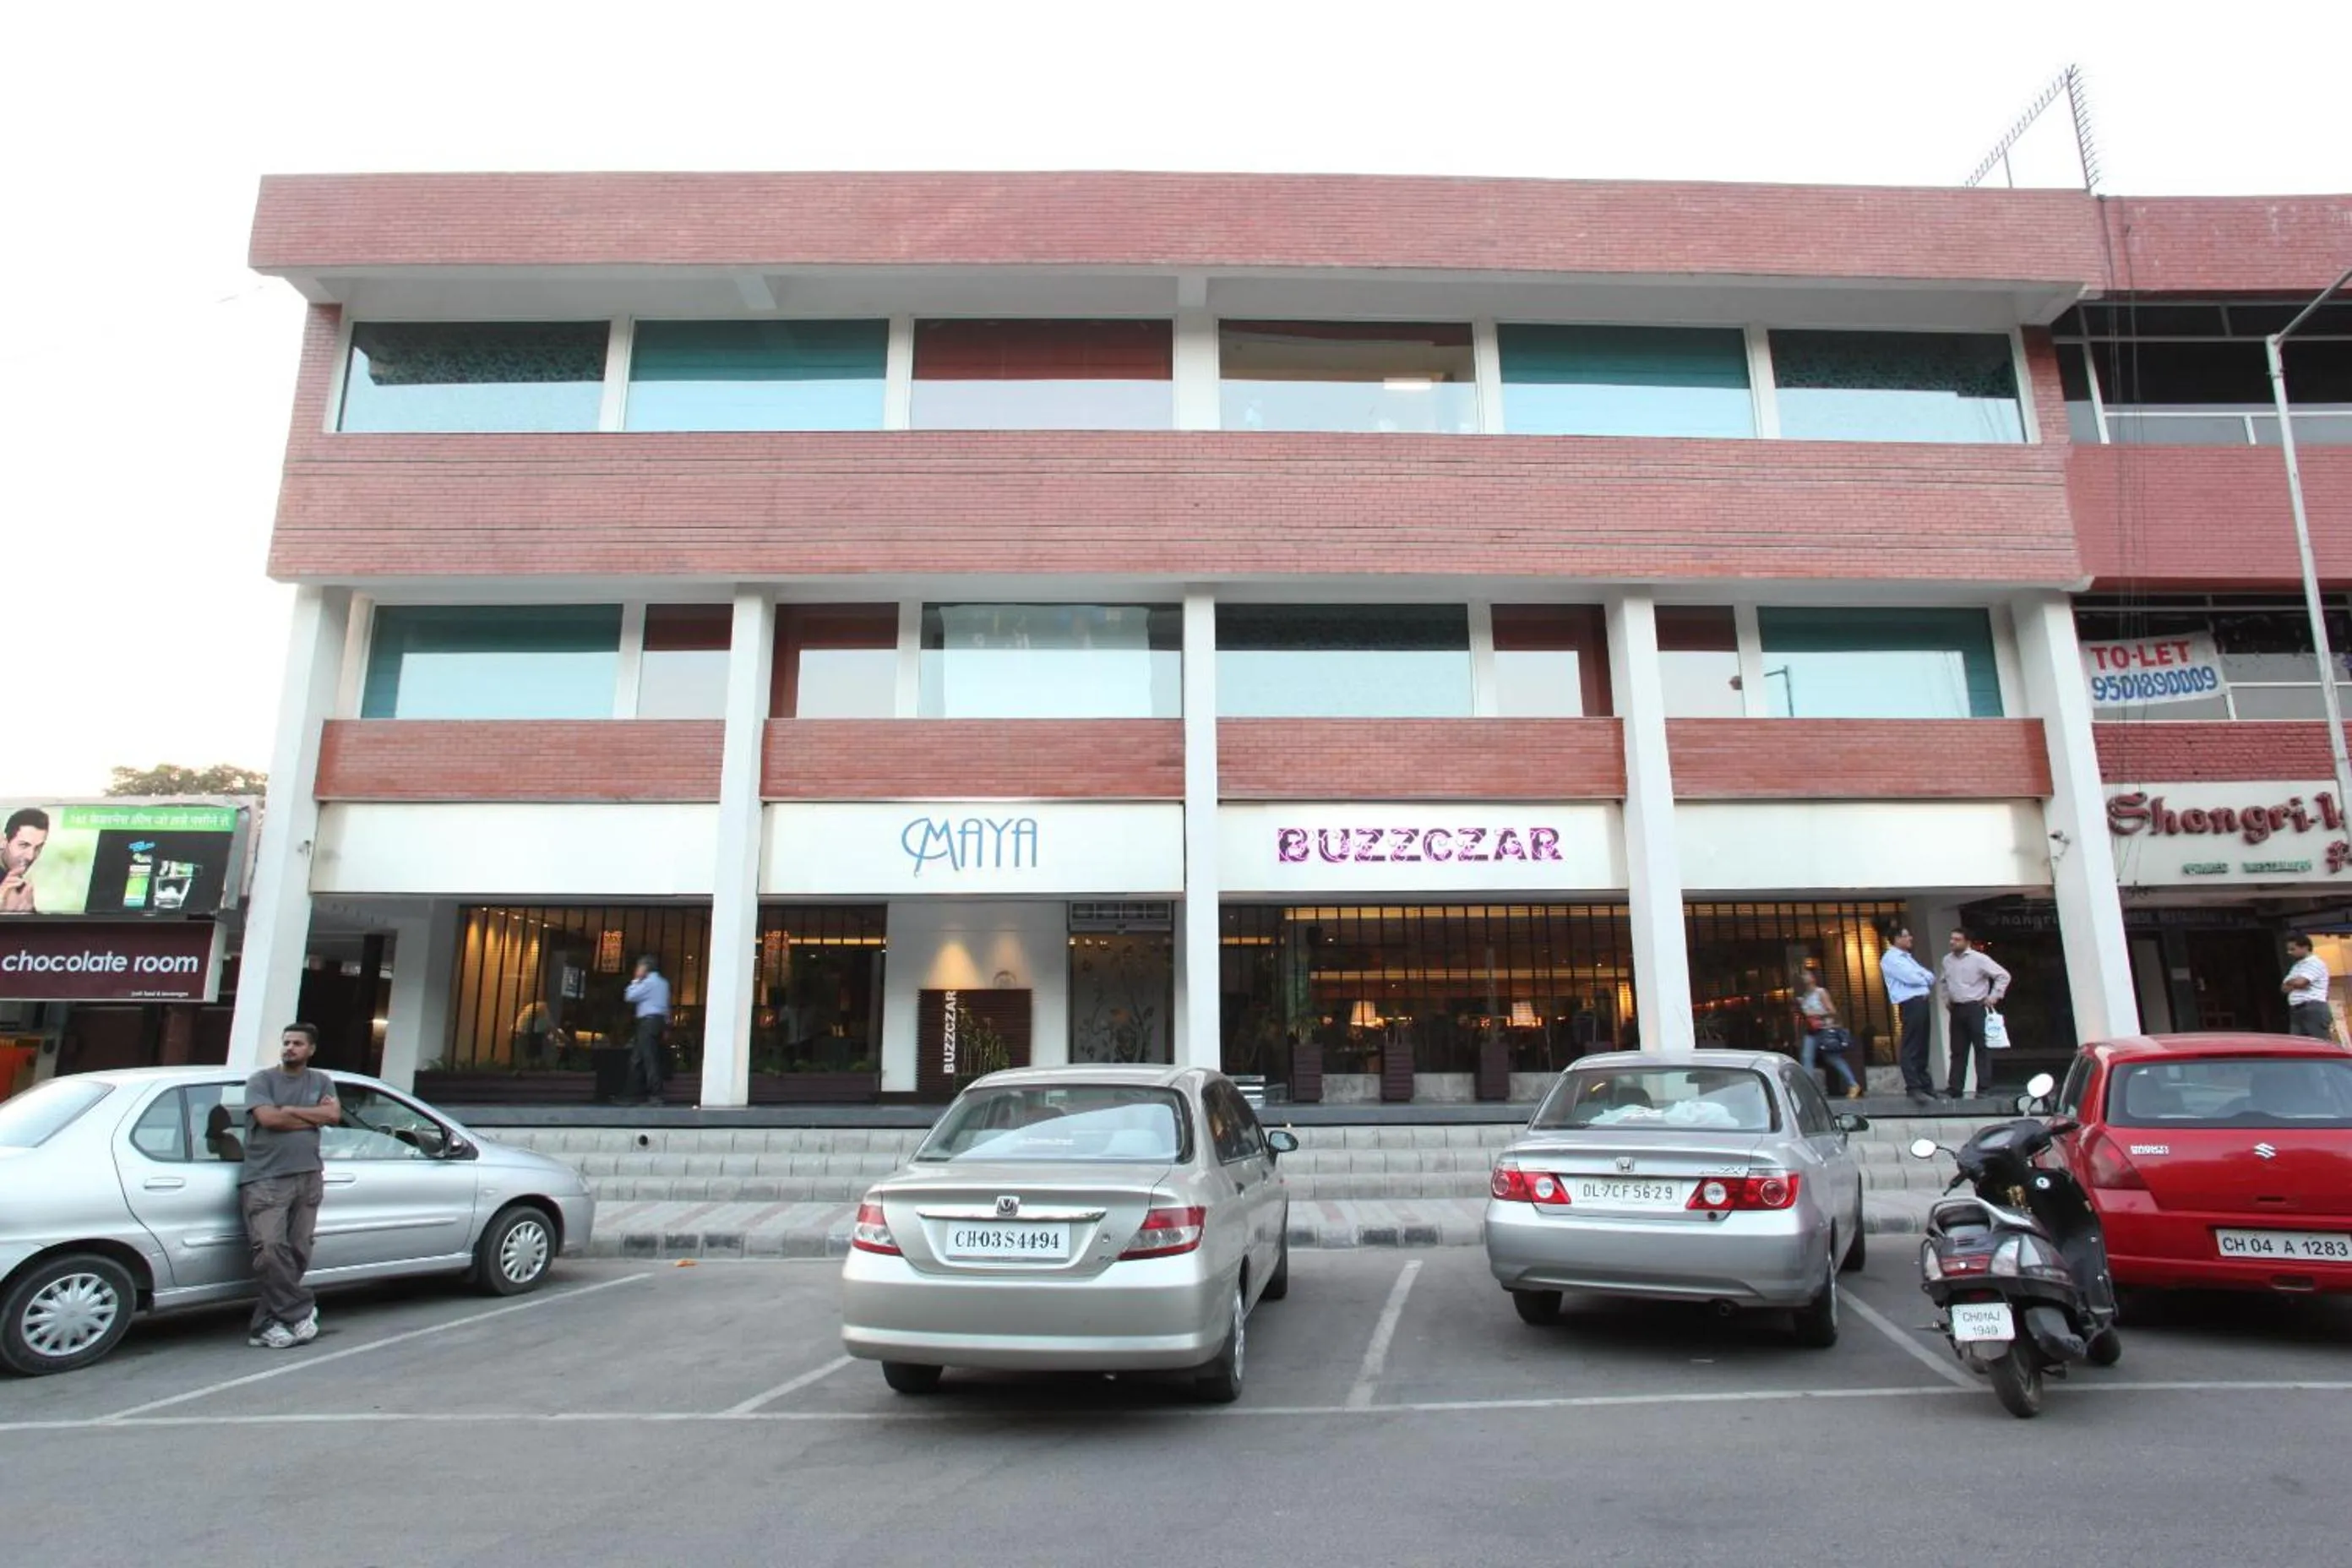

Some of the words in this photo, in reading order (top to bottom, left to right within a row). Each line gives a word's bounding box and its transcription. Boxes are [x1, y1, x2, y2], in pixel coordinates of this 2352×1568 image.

[2090, 640, 2190, 670] TO-LET
[2091, 666, 2219, 701] 9501890009
[901, 818, 1037, 878] MAYA
[1277, 827, 1564, 863] BUZZCZAR
[2, 950, 128, 972] chocolate
[133, 956, 199, 973] room
[943, 990, 957, 1074] BUZZCZAR
[2301, 1240, 2349, 1256] 1283
